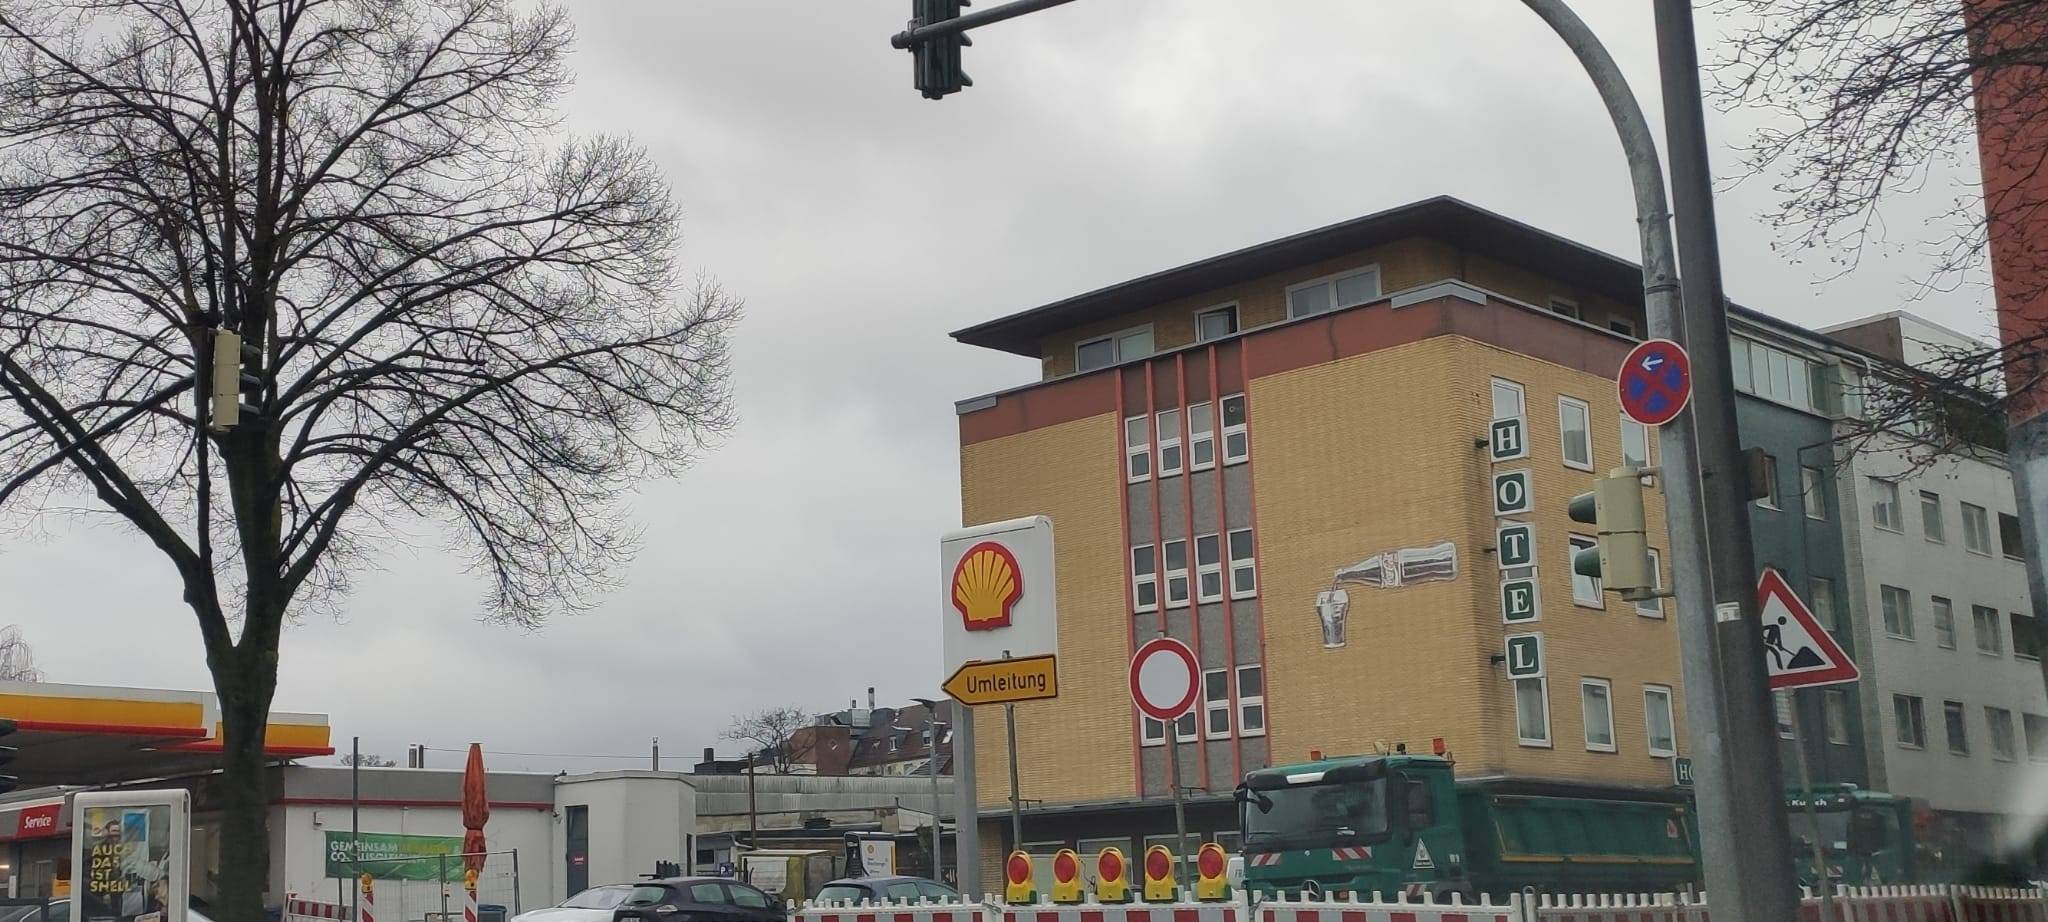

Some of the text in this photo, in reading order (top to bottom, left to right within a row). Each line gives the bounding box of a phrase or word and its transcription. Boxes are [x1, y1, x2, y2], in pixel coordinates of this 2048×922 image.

[1496, 424, 1535, 670] HOTEL
[966, 673, 1046, 693] Umleitung
[1791, 799, 1827, 807] Kuch
[24, 814, 52, 829] Service
[91, 857, 121, 869] DAS
[90, 869, 112, 881] IST
[90, 881, 132, 893] SHELL
